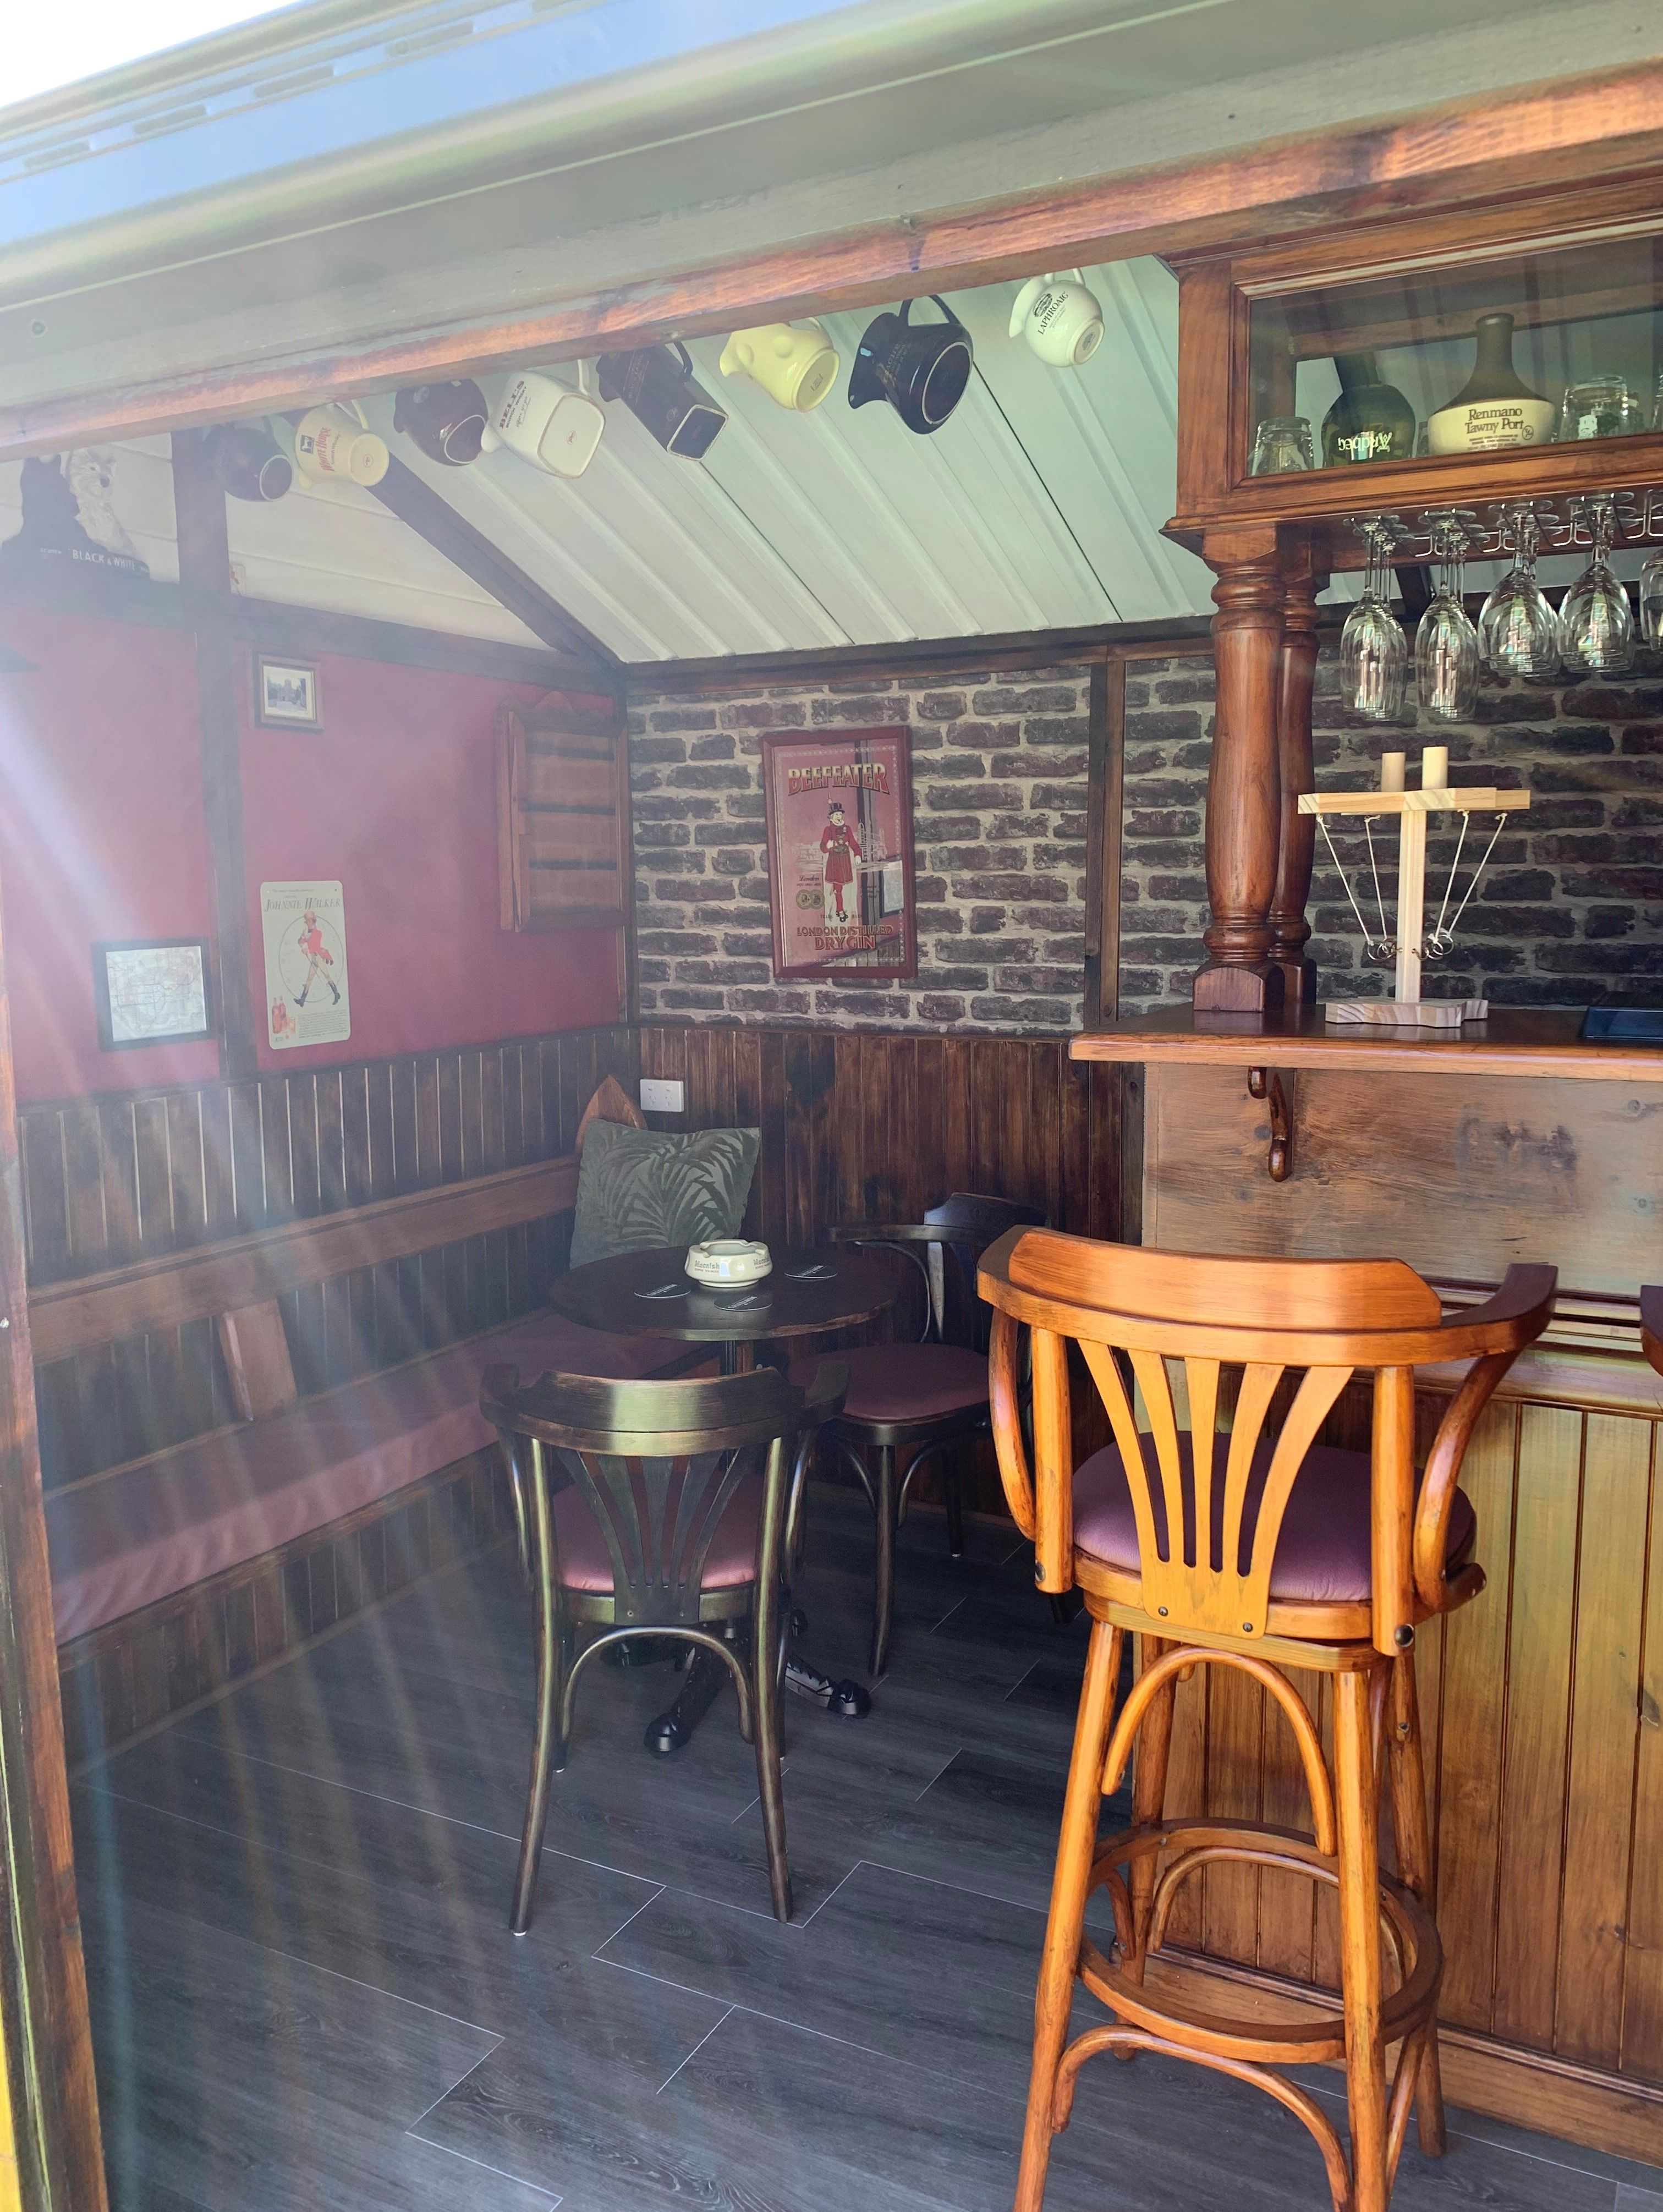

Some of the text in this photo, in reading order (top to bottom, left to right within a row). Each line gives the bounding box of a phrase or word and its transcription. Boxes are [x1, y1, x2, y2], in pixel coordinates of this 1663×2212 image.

[1038, 292, 1068, 334] LAPHROAIG
[500, 381, 524, 429] BELL'S
[1468, 408, 1522, 421] Renmano
[1465, 418, 1524, 433] Tawny Port
[315, 426, 335, 472] WHITE HORSE
[73, 549, 105, 564] BLACK
[114, 557, 135, 570] WHITE
[788, 762, 890, 796] BEEFEATER
[797, 925, 894, 936] LONDON DISTILLED
[815, 935, 876, 950] DRY GIN
